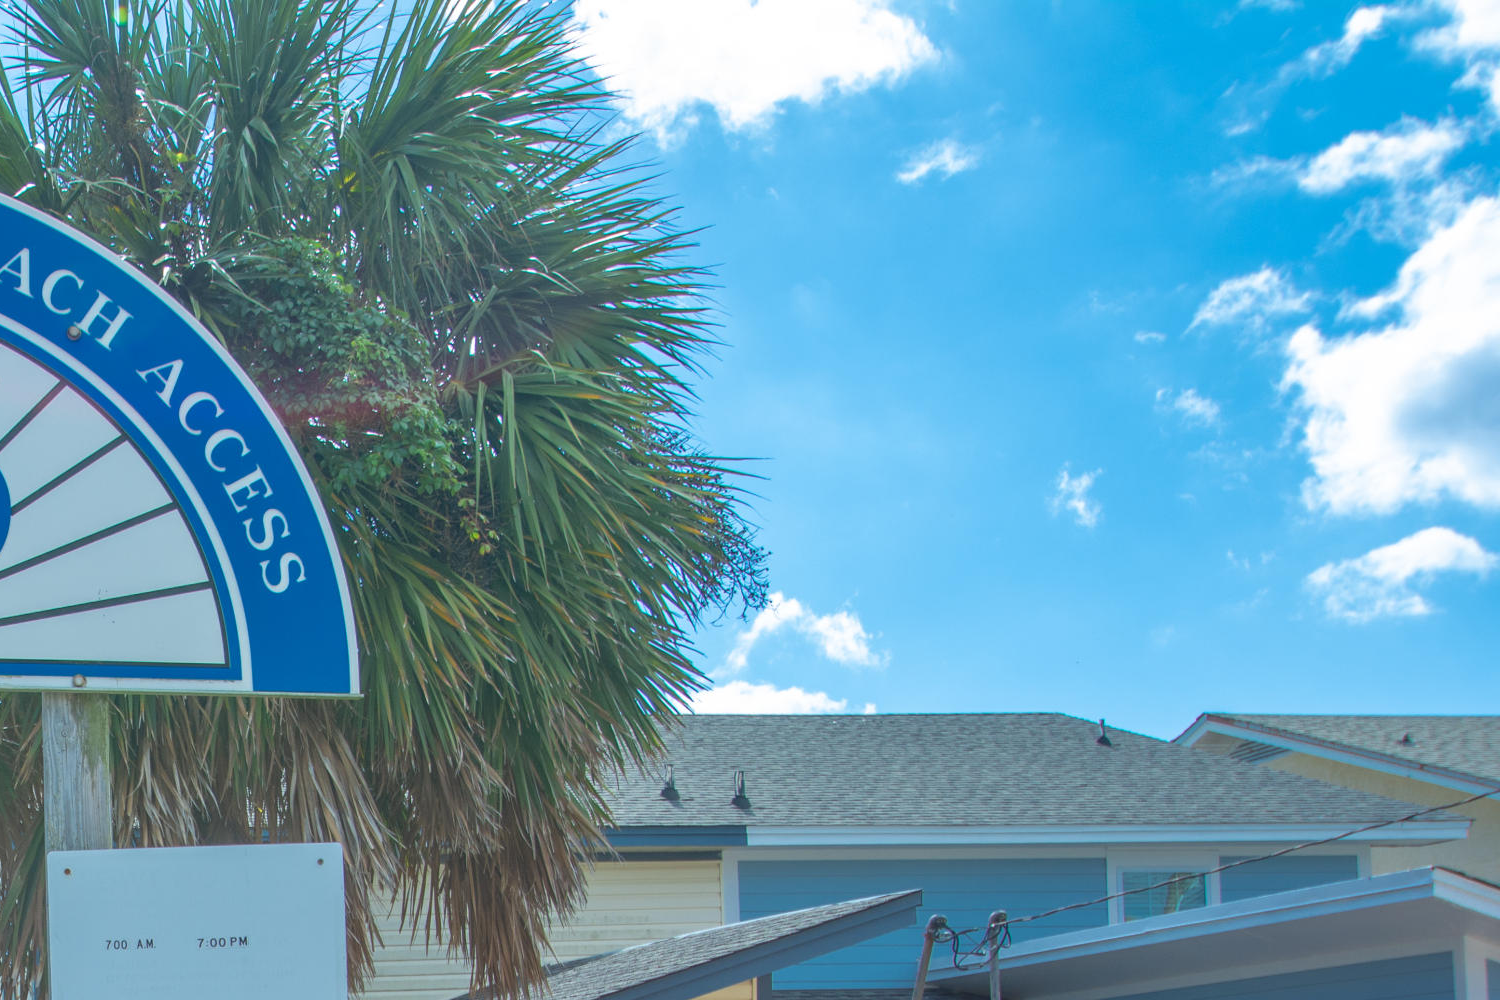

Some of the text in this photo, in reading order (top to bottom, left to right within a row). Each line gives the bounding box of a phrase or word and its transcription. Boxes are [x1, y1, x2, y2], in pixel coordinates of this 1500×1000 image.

[135, 358, 307, 594] ACCESS
[197, 938, 226, 948] 7:00
[230, 936, 248, 946] PM
